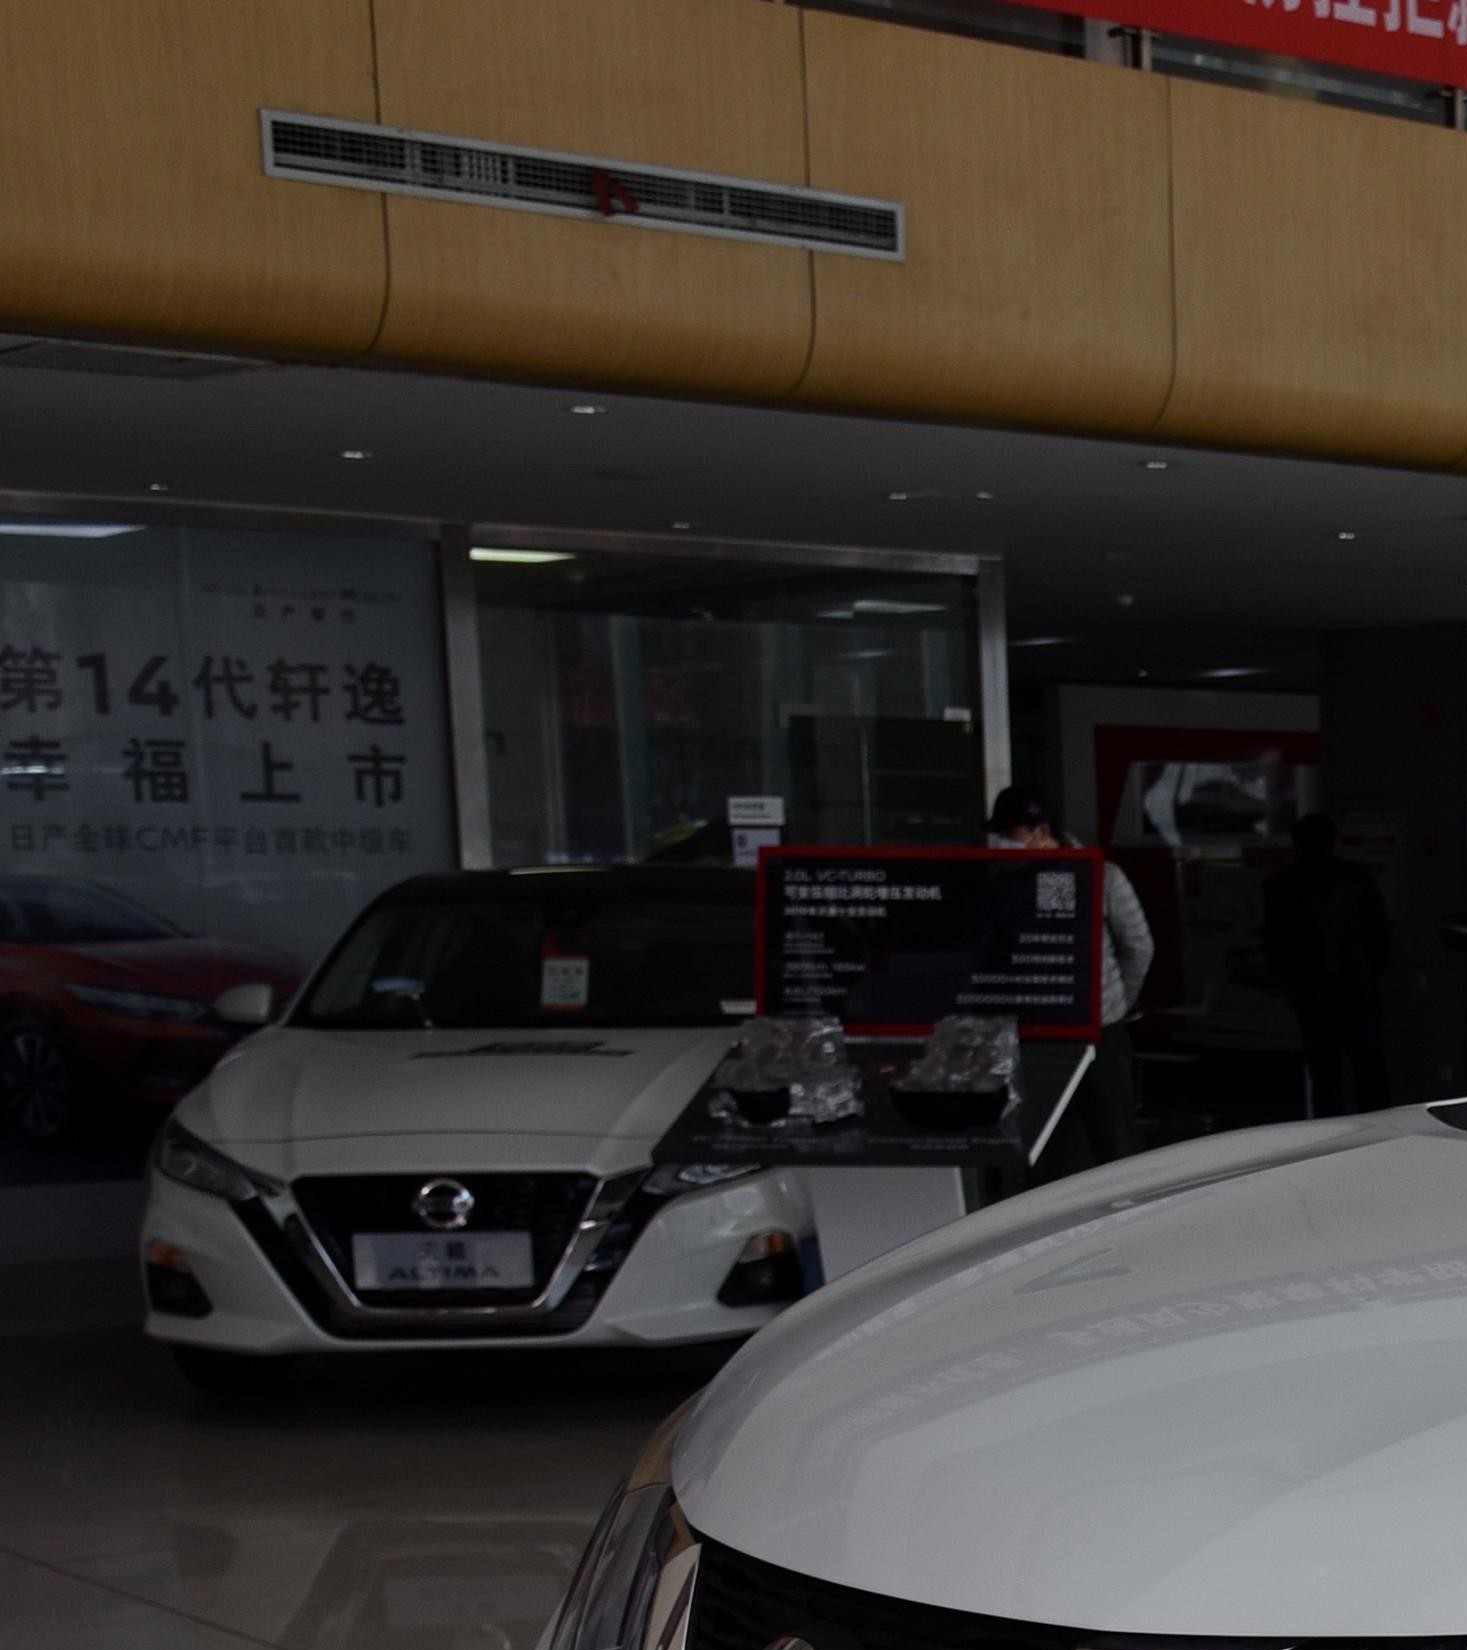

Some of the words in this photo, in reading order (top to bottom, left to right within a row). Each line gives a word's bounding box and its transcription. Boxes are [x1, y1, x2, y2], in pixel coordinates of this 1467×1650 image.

[0, 645, 406, 726] 第14代轩逸
[4, 734, 406, 807] 幸福上市
